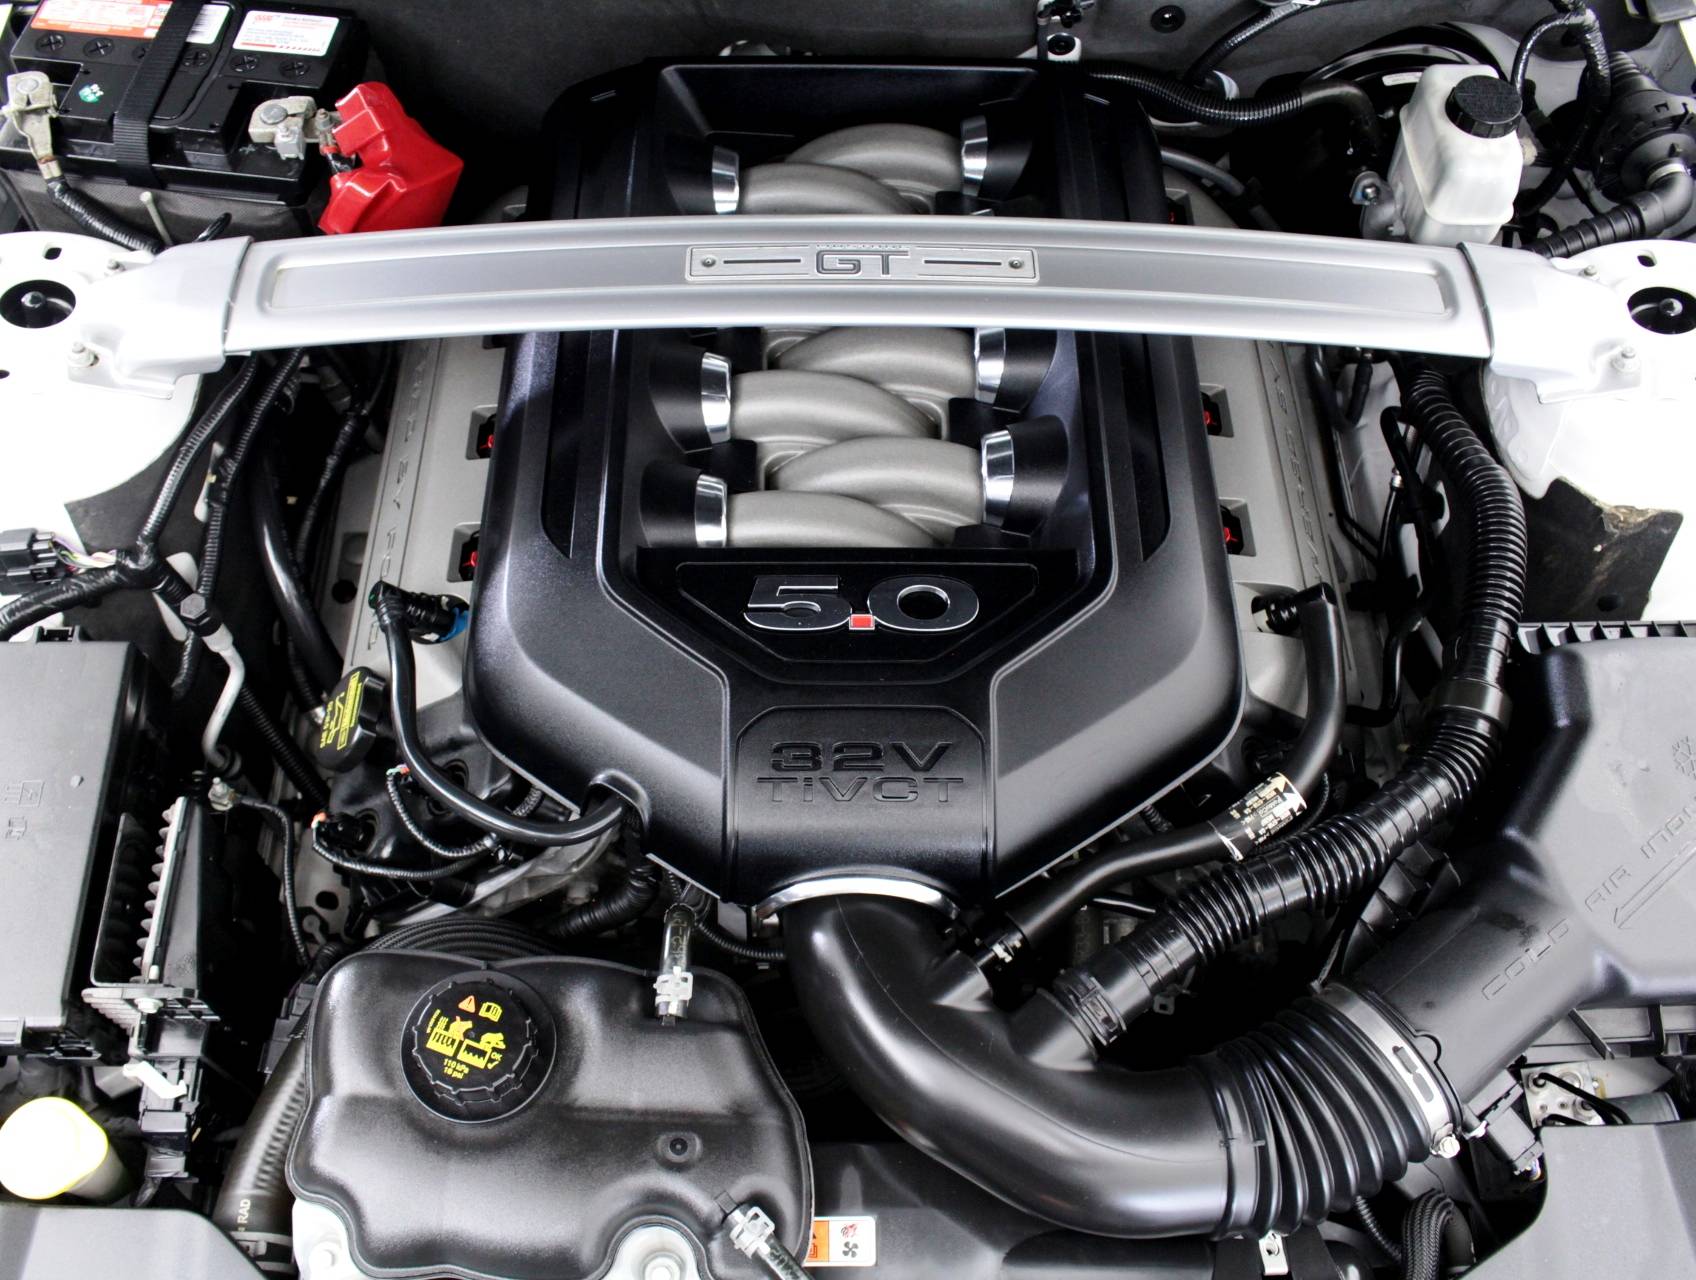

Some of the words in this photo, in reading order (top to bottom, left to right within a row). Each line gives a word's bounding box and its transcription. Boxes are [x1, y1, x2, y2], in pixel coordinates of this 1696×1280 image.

[816, 250, 910, 275] GT
[367, 526, 397, 651] FOD
[743, 574, 979, 631] 5.0
[771, 741, 952, 772] 32V
[1481, 918, 1570, 1000] COLD
[1585, 864, 1632, 912] AIR
[237, 1199, 251, 1223] RAD
